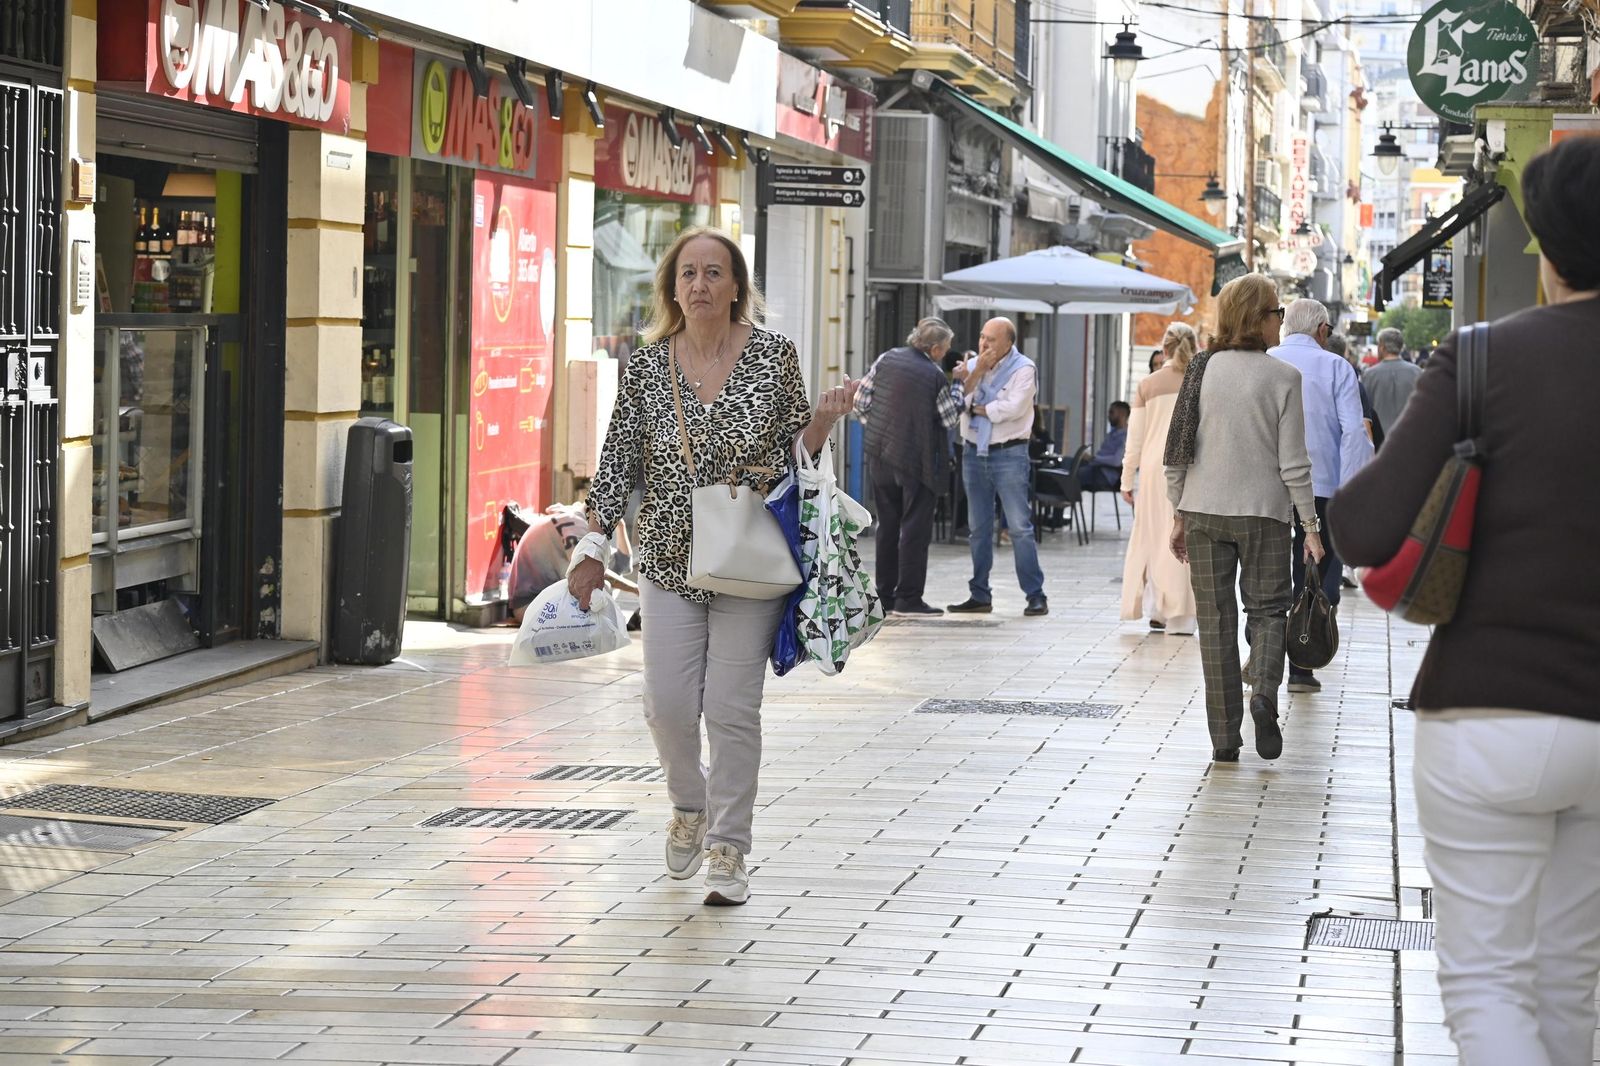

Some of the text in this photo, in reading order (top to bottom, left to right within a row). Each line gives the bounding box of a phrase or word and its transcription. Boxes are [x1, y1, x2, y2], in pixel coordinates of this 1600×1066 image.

[1486, 25, 1528, 42] Tiendas
[441, 66, 535, 170] MAS&GO
[635, 116, 696, 196] MAS&GO
[807, 168, 832, 176] Milagrosa
[775, 189, 796, 197] Antigua
[826, 190, 843, 198] Sevilla
[1120, 286, 1174, 298] Cruzcampo
